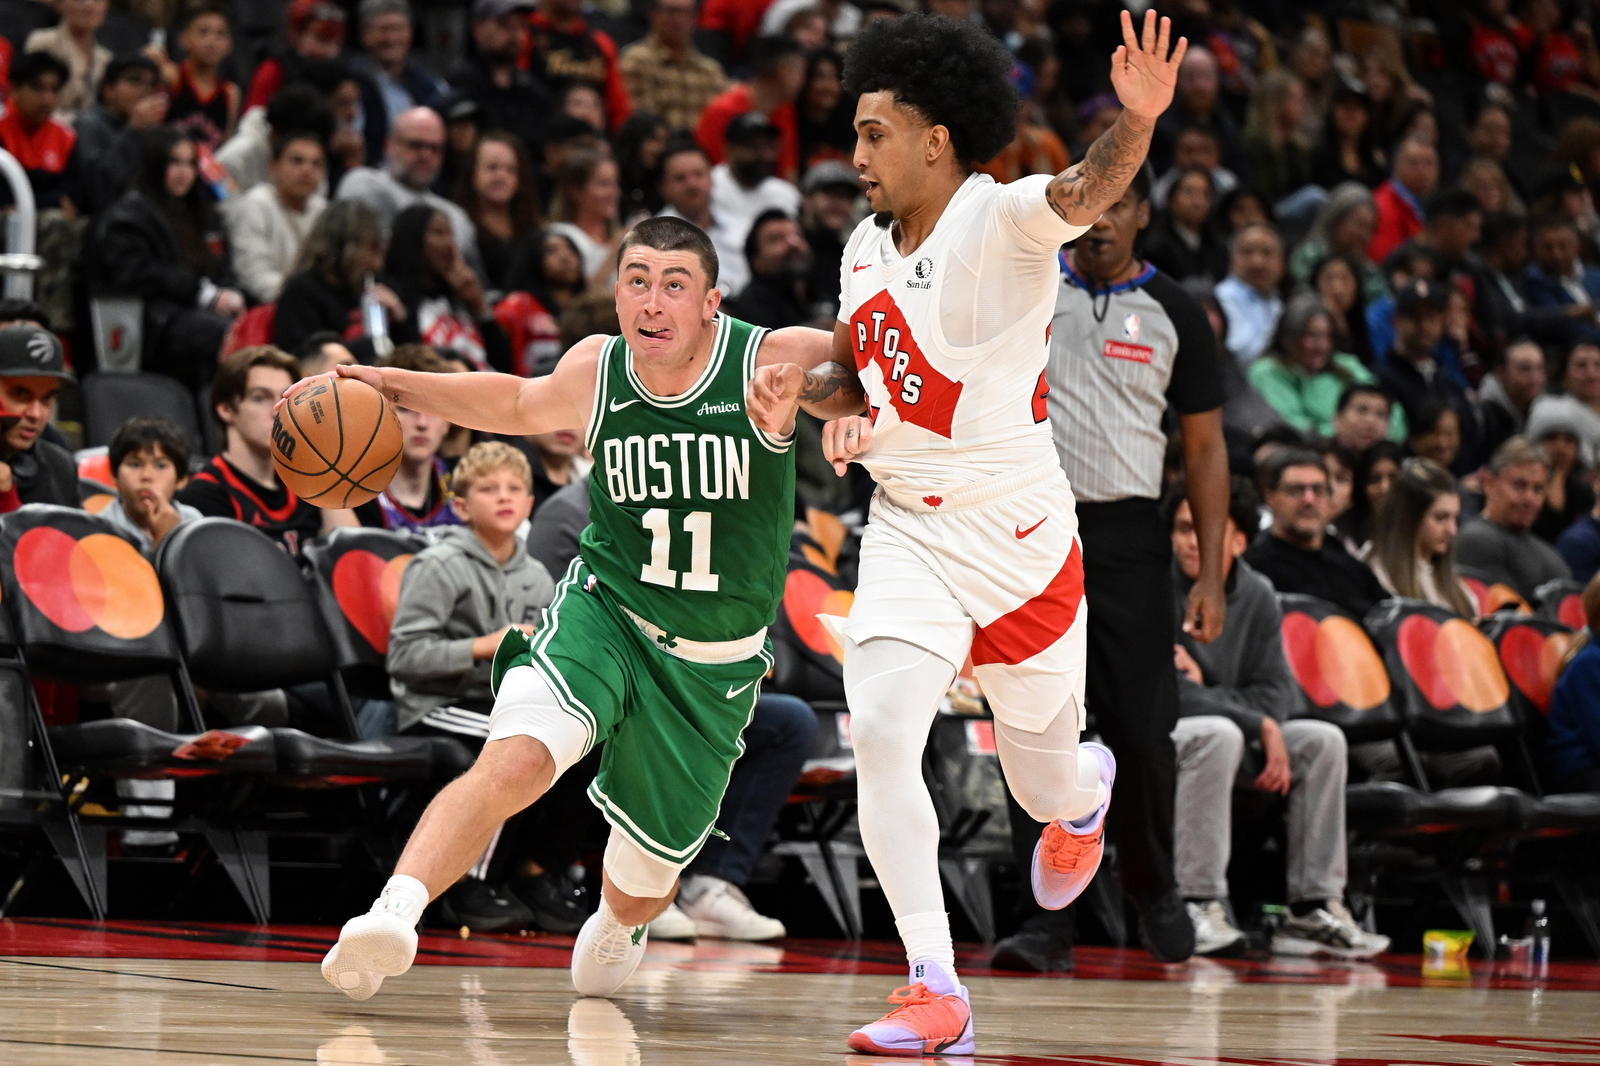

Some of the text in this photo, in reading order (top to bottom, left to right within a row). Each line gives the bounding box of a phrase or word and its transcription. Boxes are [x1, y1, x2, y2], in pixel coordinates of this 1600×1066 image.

[906, 279, 920, 289] Sun
[696, 401, 741, 416] Amica
[603, 433, 750, 503] BOSTON
[640, 507, 719, 592] 11
